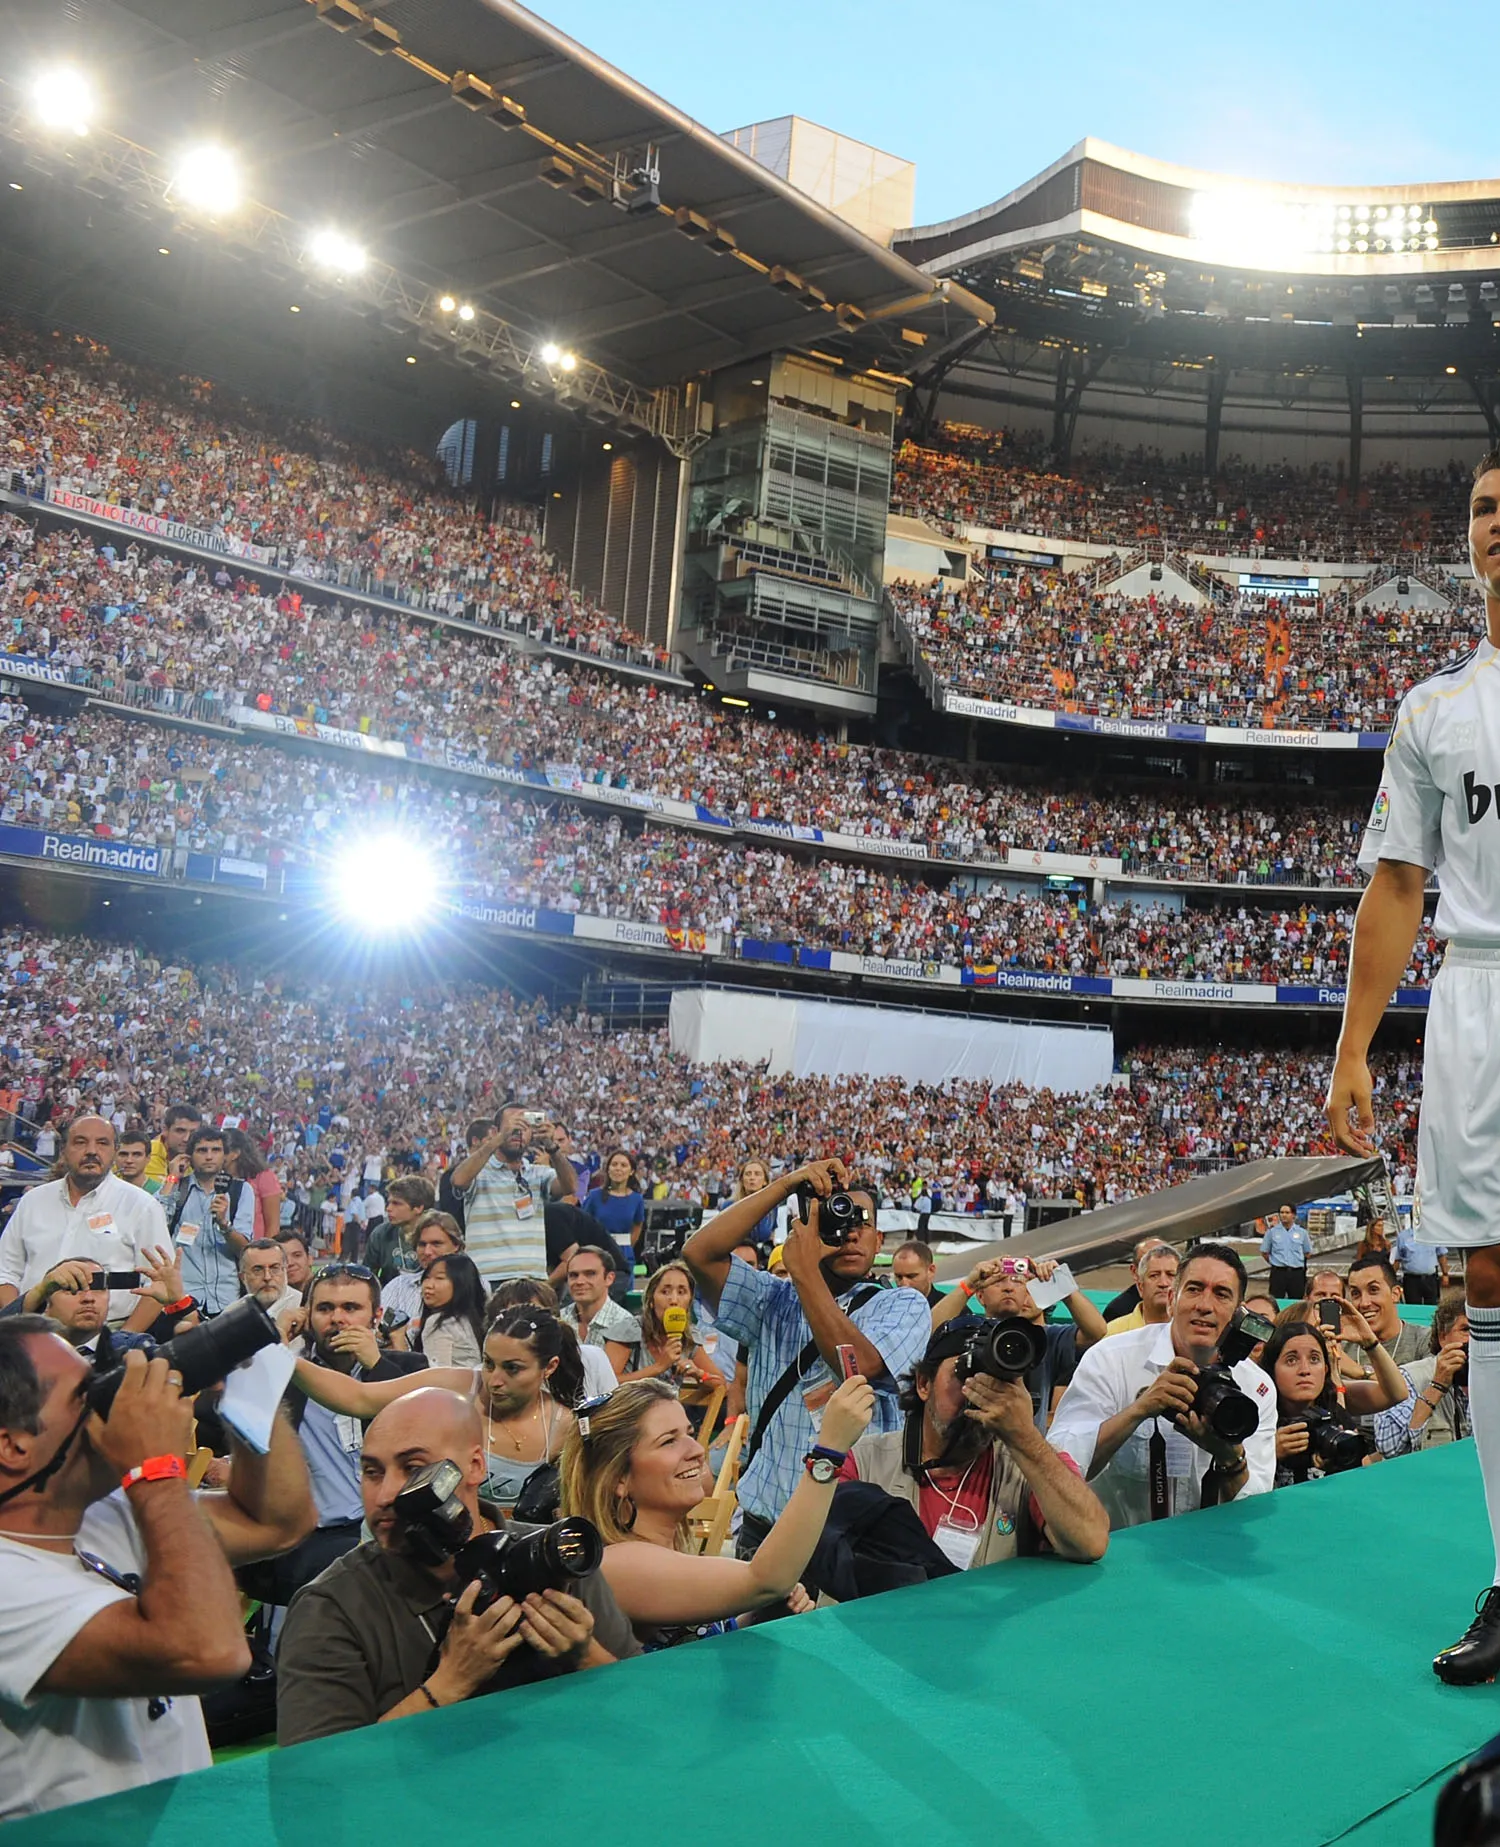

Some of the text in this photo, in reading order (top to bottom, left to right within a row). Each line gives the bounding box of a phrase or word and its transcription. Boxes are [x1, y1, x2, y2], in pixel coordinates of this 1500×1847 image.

[54, 488, 120, 521] CRISTIANO
[948, 698, 1018, 720] Realmadrid
[1094, 718, 1168, 738] Realmadrid
[1245, 730, 1319, 746] Realmadrid
[448, 754, 525, 783] Realmadrid
[42, 835, 158, 872] Realmadrid
[855, 836, 927, 860] Realmadrid
[862, 956, 924, 979] Realmadrid
[998, 971, 1072, 992] Realmadrid
[1154, 982, 1233, 1000] Realmadrid
[1155, 1460, 1164, 1504] DIGITAL
